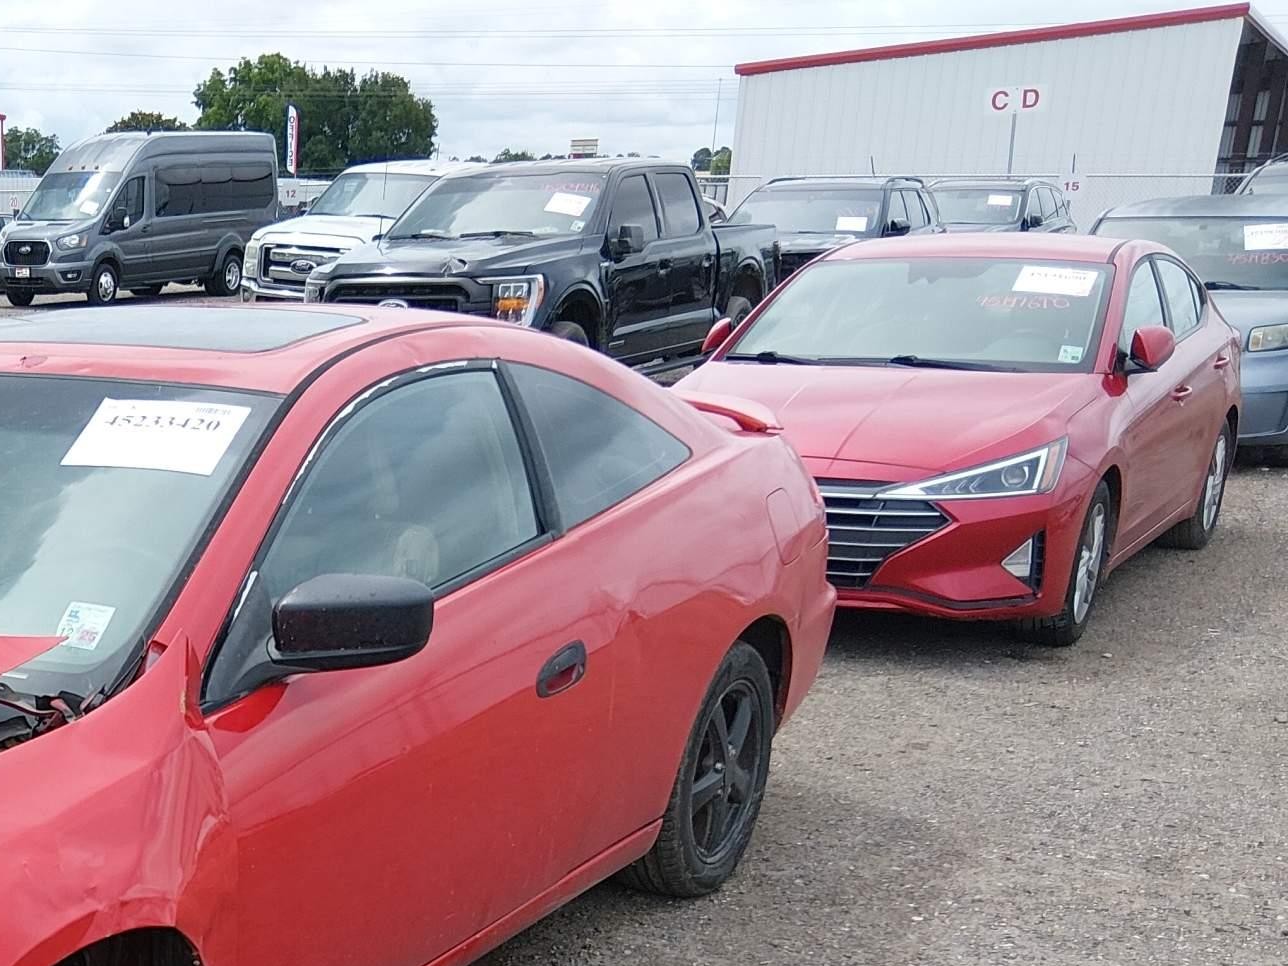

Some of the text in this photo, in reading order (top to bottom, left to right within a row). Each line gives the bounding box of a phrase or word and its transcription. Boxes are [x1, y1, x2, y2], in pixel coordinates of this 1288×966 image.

[991, 88, 1040, 111] C D
[1064, 181, 1080, 192] 15
[286, 190, 296, 199] 12
[105, 414, 221, 431] 45233420
